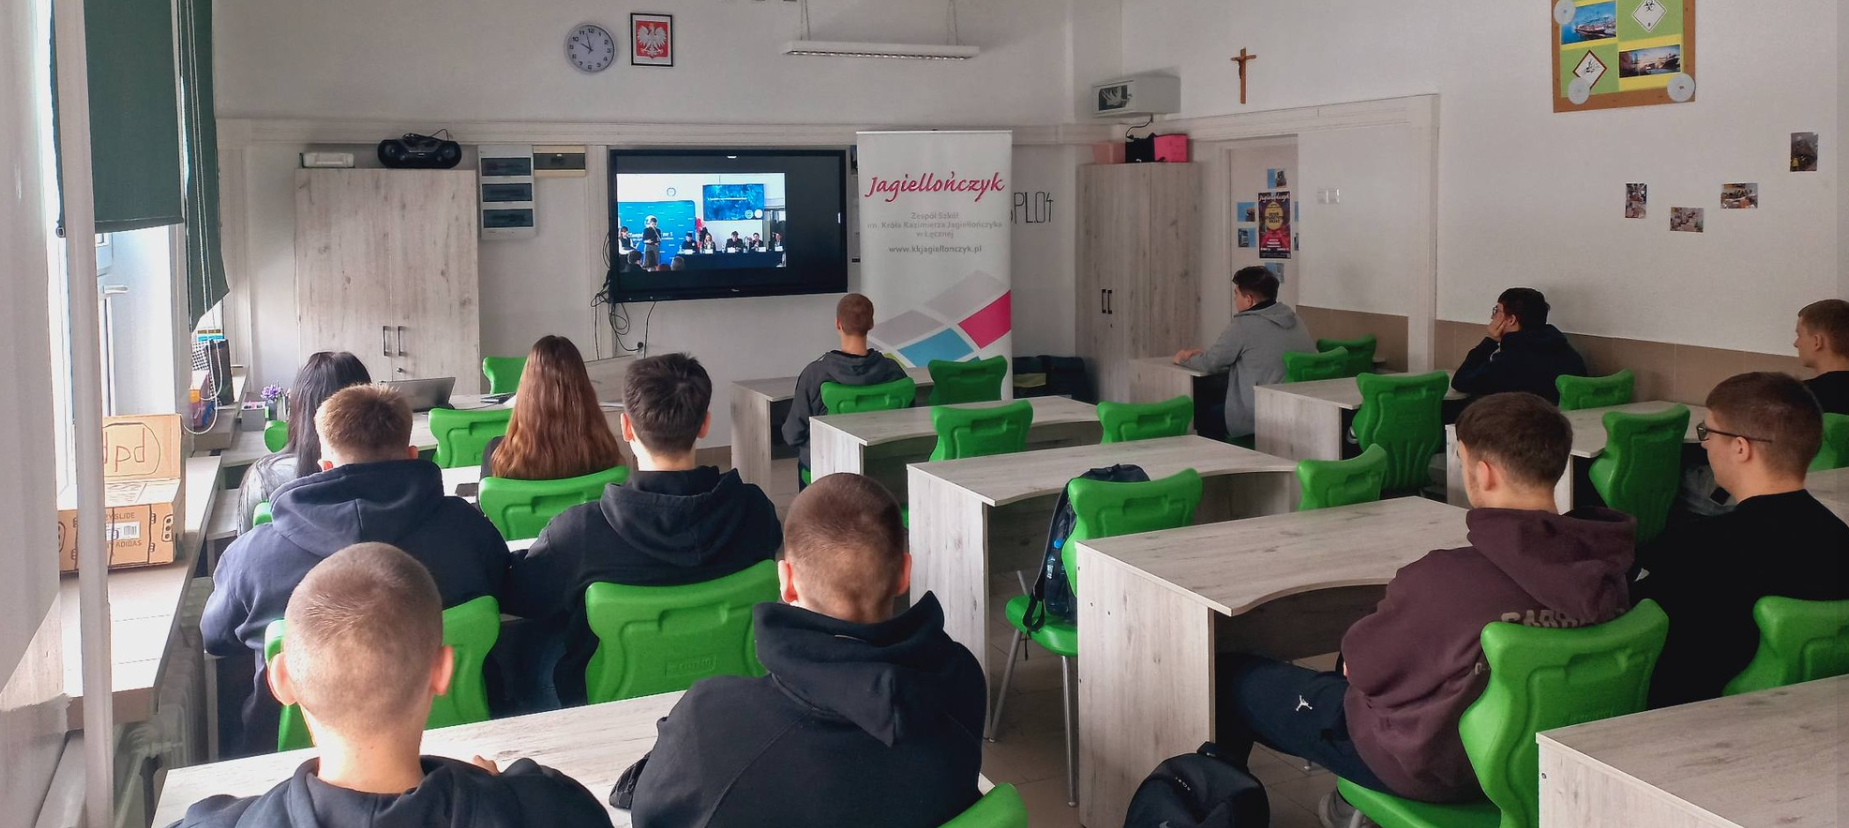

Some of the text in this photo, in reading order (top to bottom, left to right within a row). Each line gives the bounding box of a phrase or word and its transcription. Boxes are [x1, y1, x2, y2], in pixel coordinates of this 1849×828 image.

[864, 171, 1005, 203] Jagiellończyk
[911, 211, 959, 221] Zespół Szkół
[881, 221, 902, 229] Króla
[903, 221, 946, 229] Kazimierza
[115, 539, 143, 548] ADIDAS
